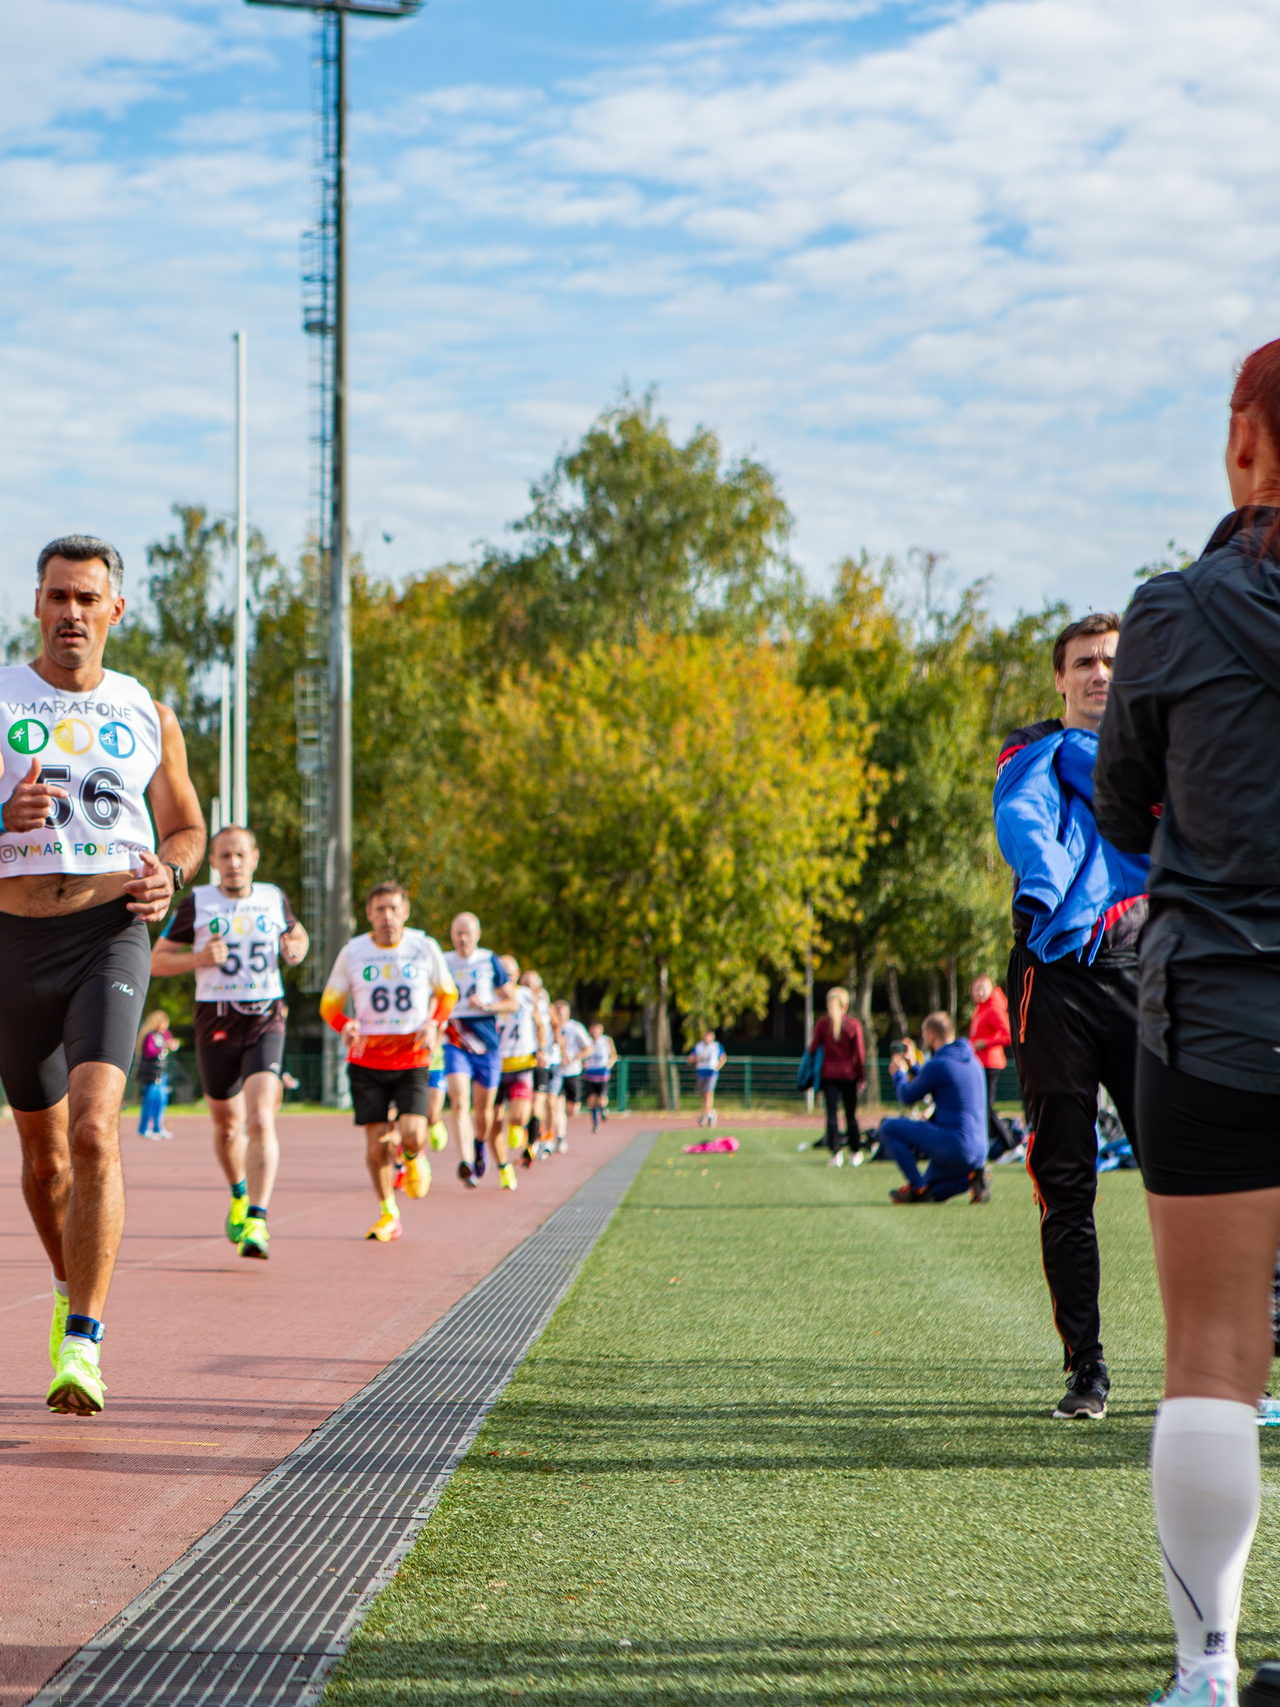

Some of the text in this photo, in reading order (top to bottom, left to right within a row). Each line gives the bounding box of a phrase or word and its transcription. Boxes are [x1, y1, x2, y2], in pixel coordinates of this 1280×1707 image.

[6, 700, 133, 721] VMARAFONE
[35, 764, 125, 830] 56
[221, 941, 268, 977] 55
[111, 981, 134, 997] FILA
[371, 985, 413, 1014] 68
